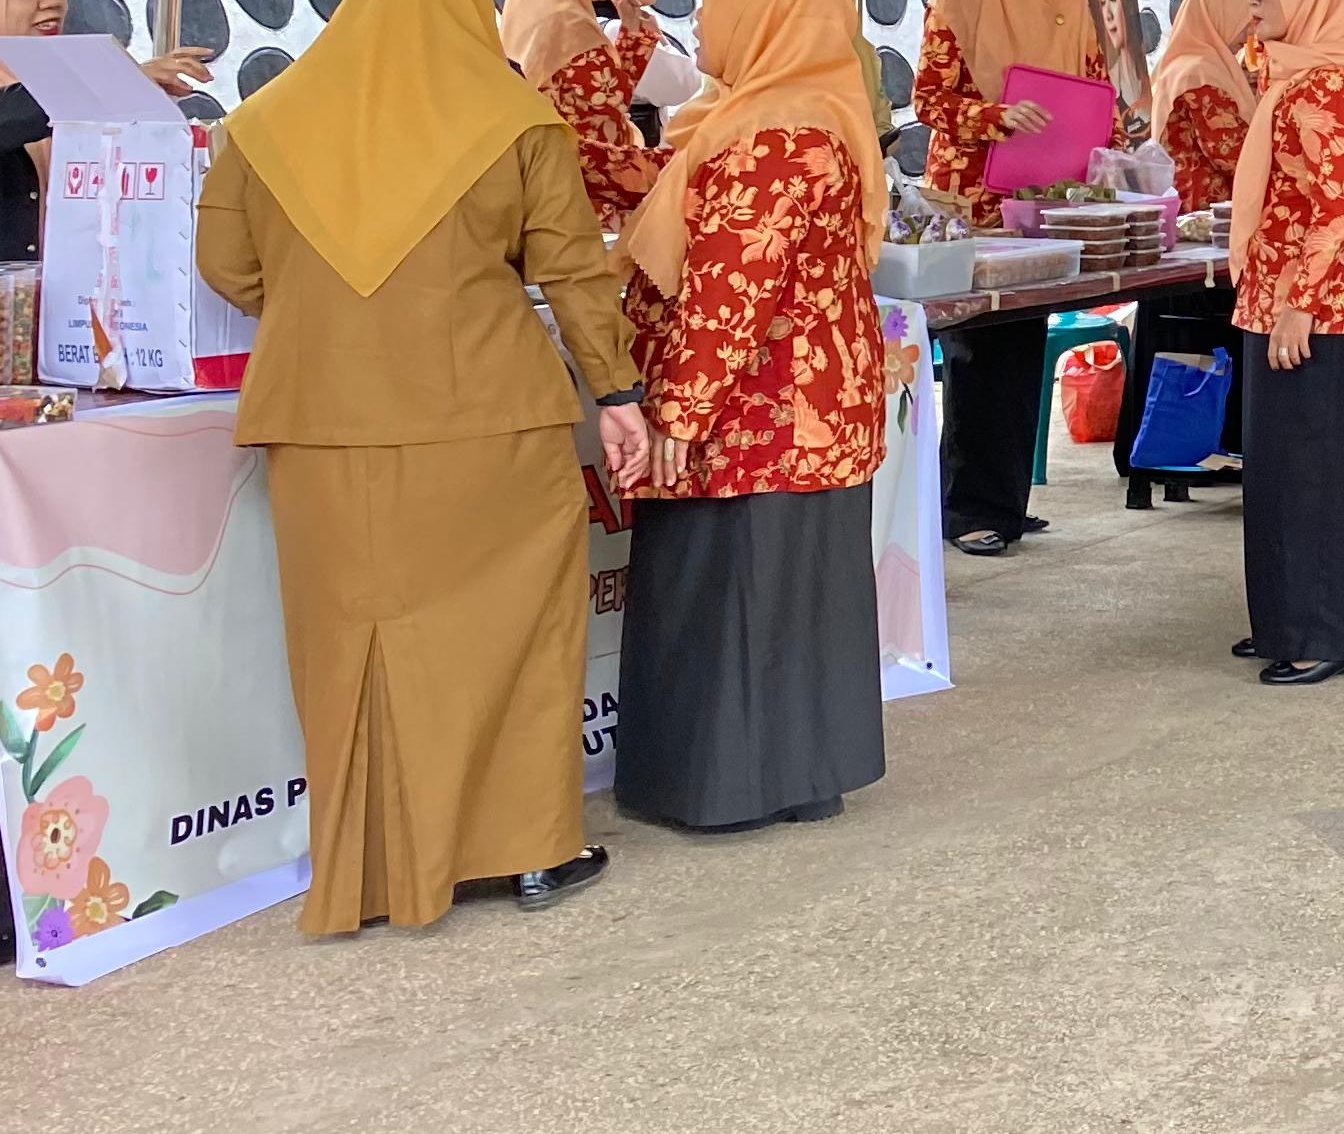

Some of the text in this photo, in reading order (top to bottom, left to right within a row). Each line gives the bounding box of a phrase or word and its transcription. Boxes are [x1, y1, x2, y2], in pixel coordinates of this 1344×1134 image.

[58, 344, 90, 364] BERAT
[136, 348, 147, 366] 12
[148, 348, 163, 367] KG
[171, 787, 275, 845] DINAS
